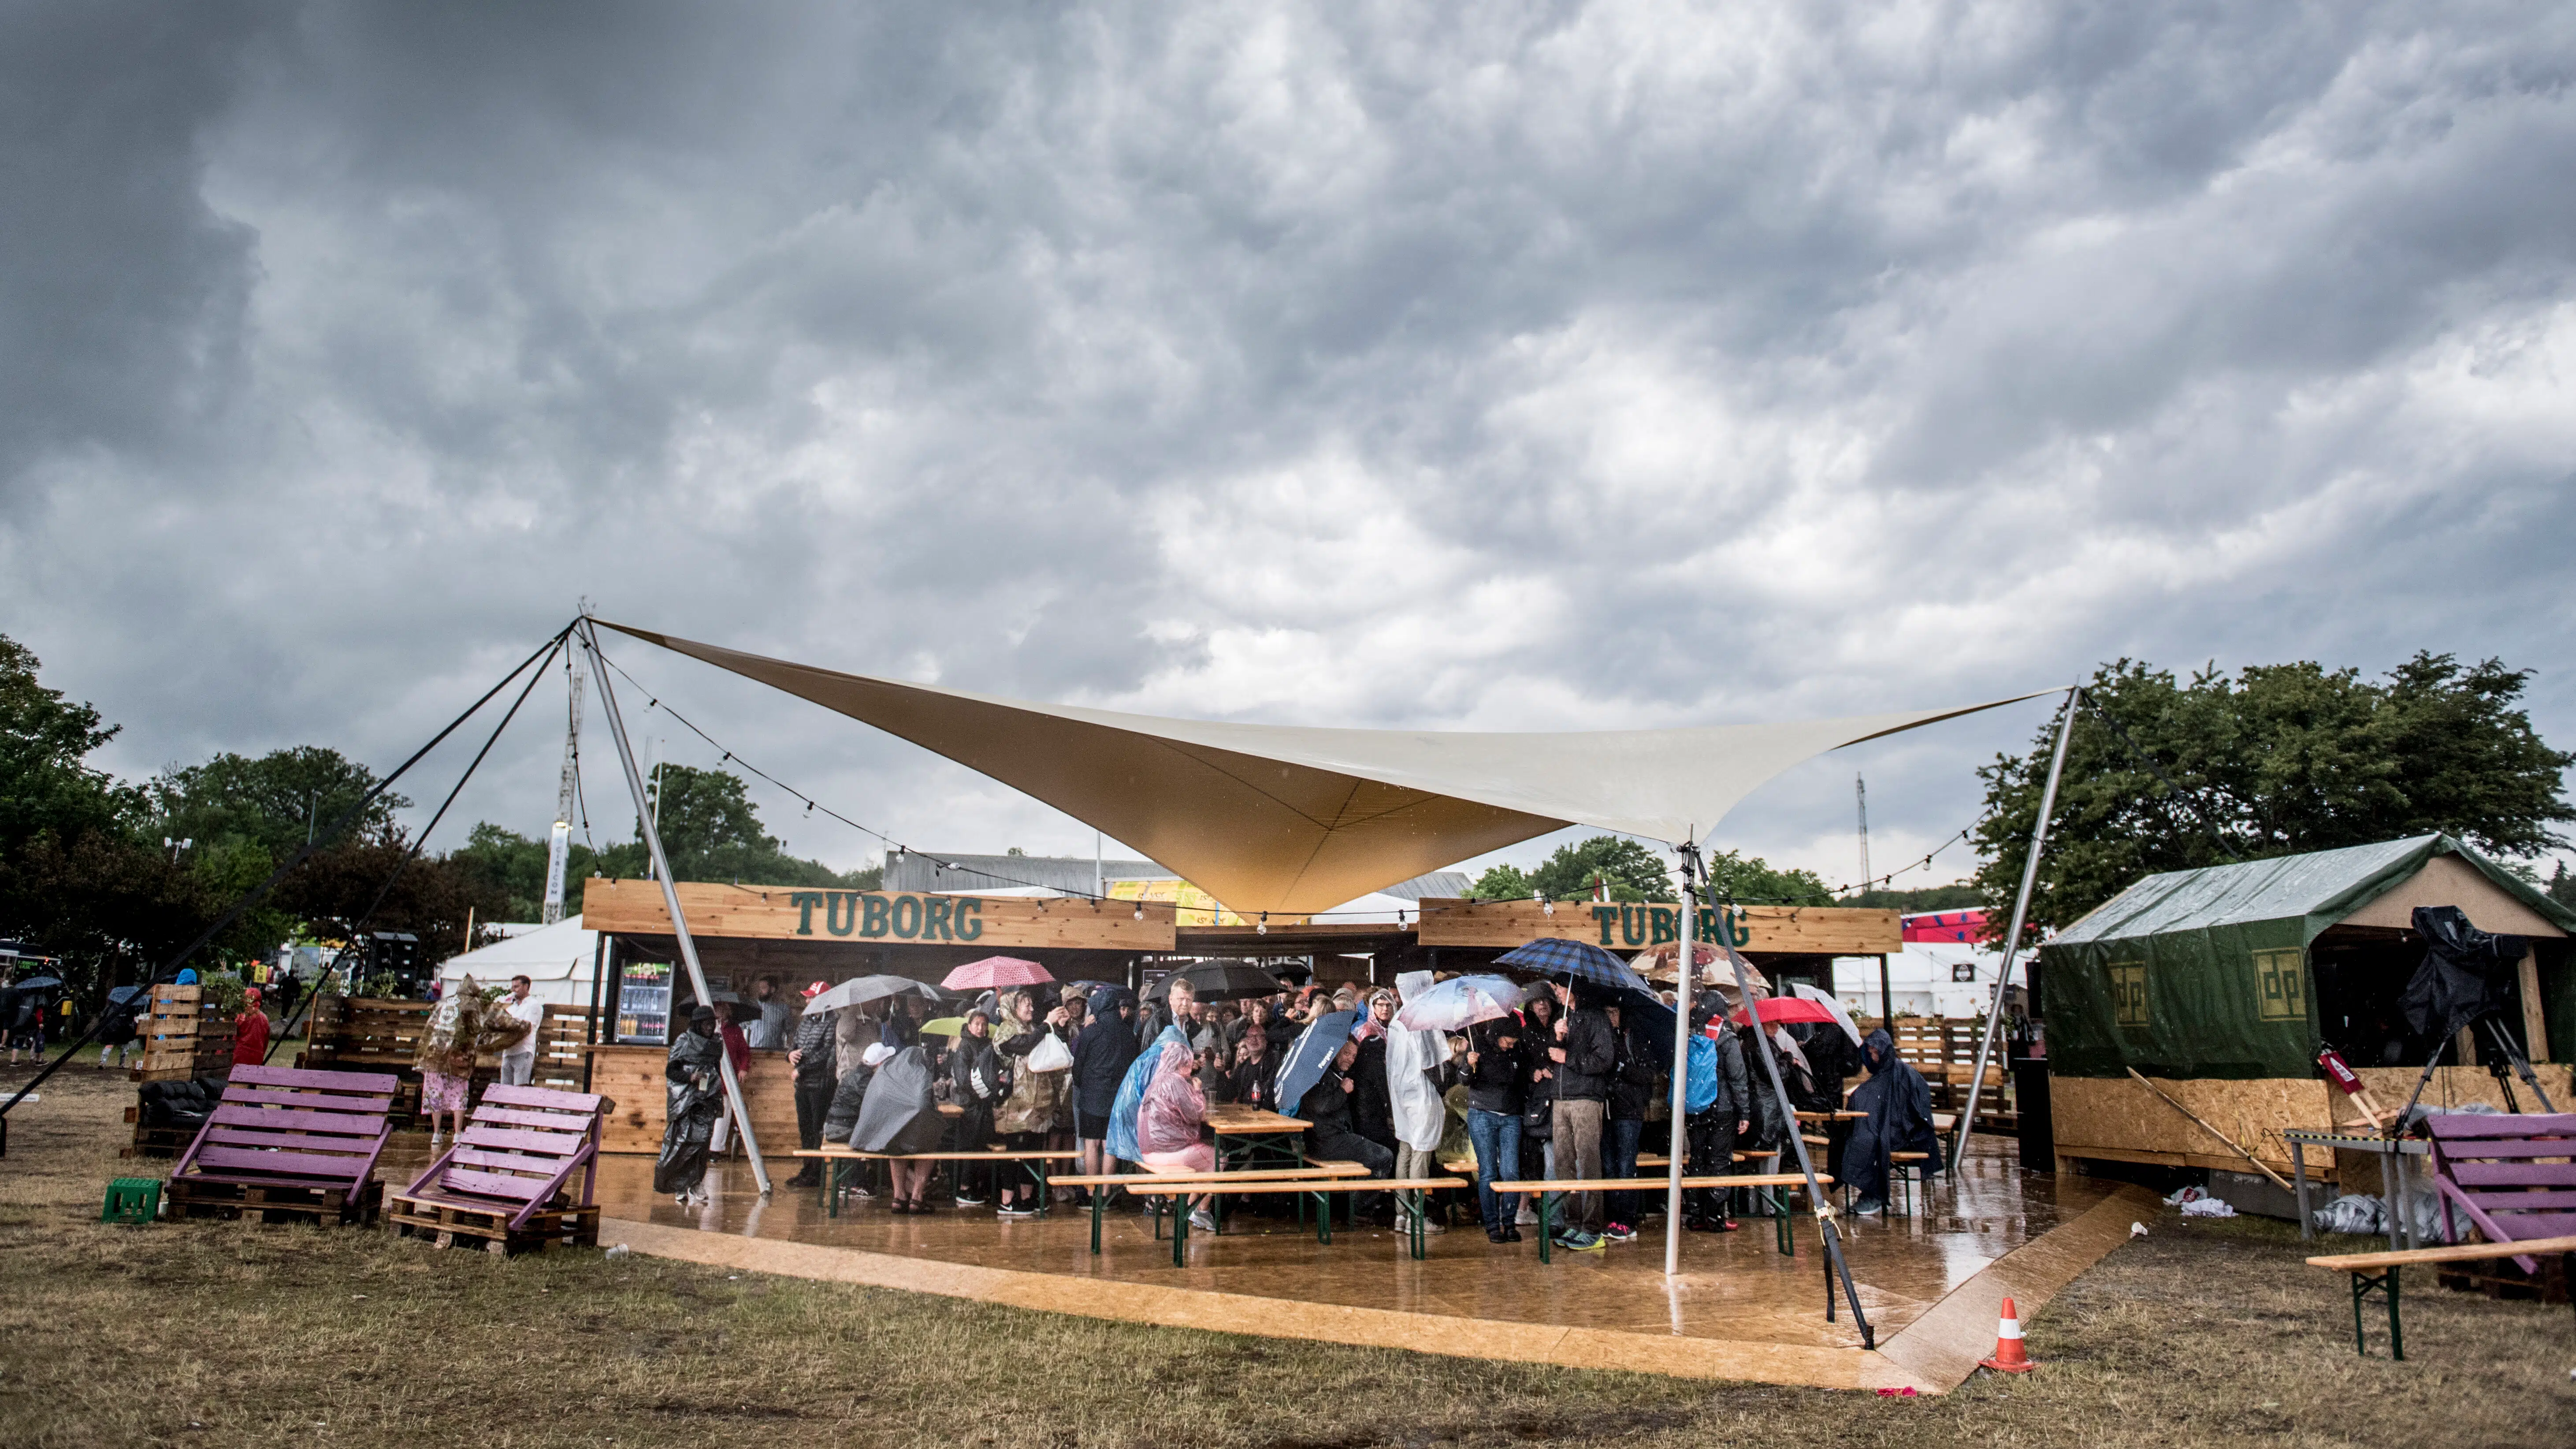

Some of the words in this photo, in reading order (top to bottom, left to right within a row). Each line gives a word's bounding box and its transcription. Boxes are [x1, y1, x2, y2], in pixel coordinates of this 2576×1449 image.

[551, 846, 561, 895] CIBICOM
[791, 892, 982, 940] TUBORG
[970, 1066, 991, 1099] NIKE
